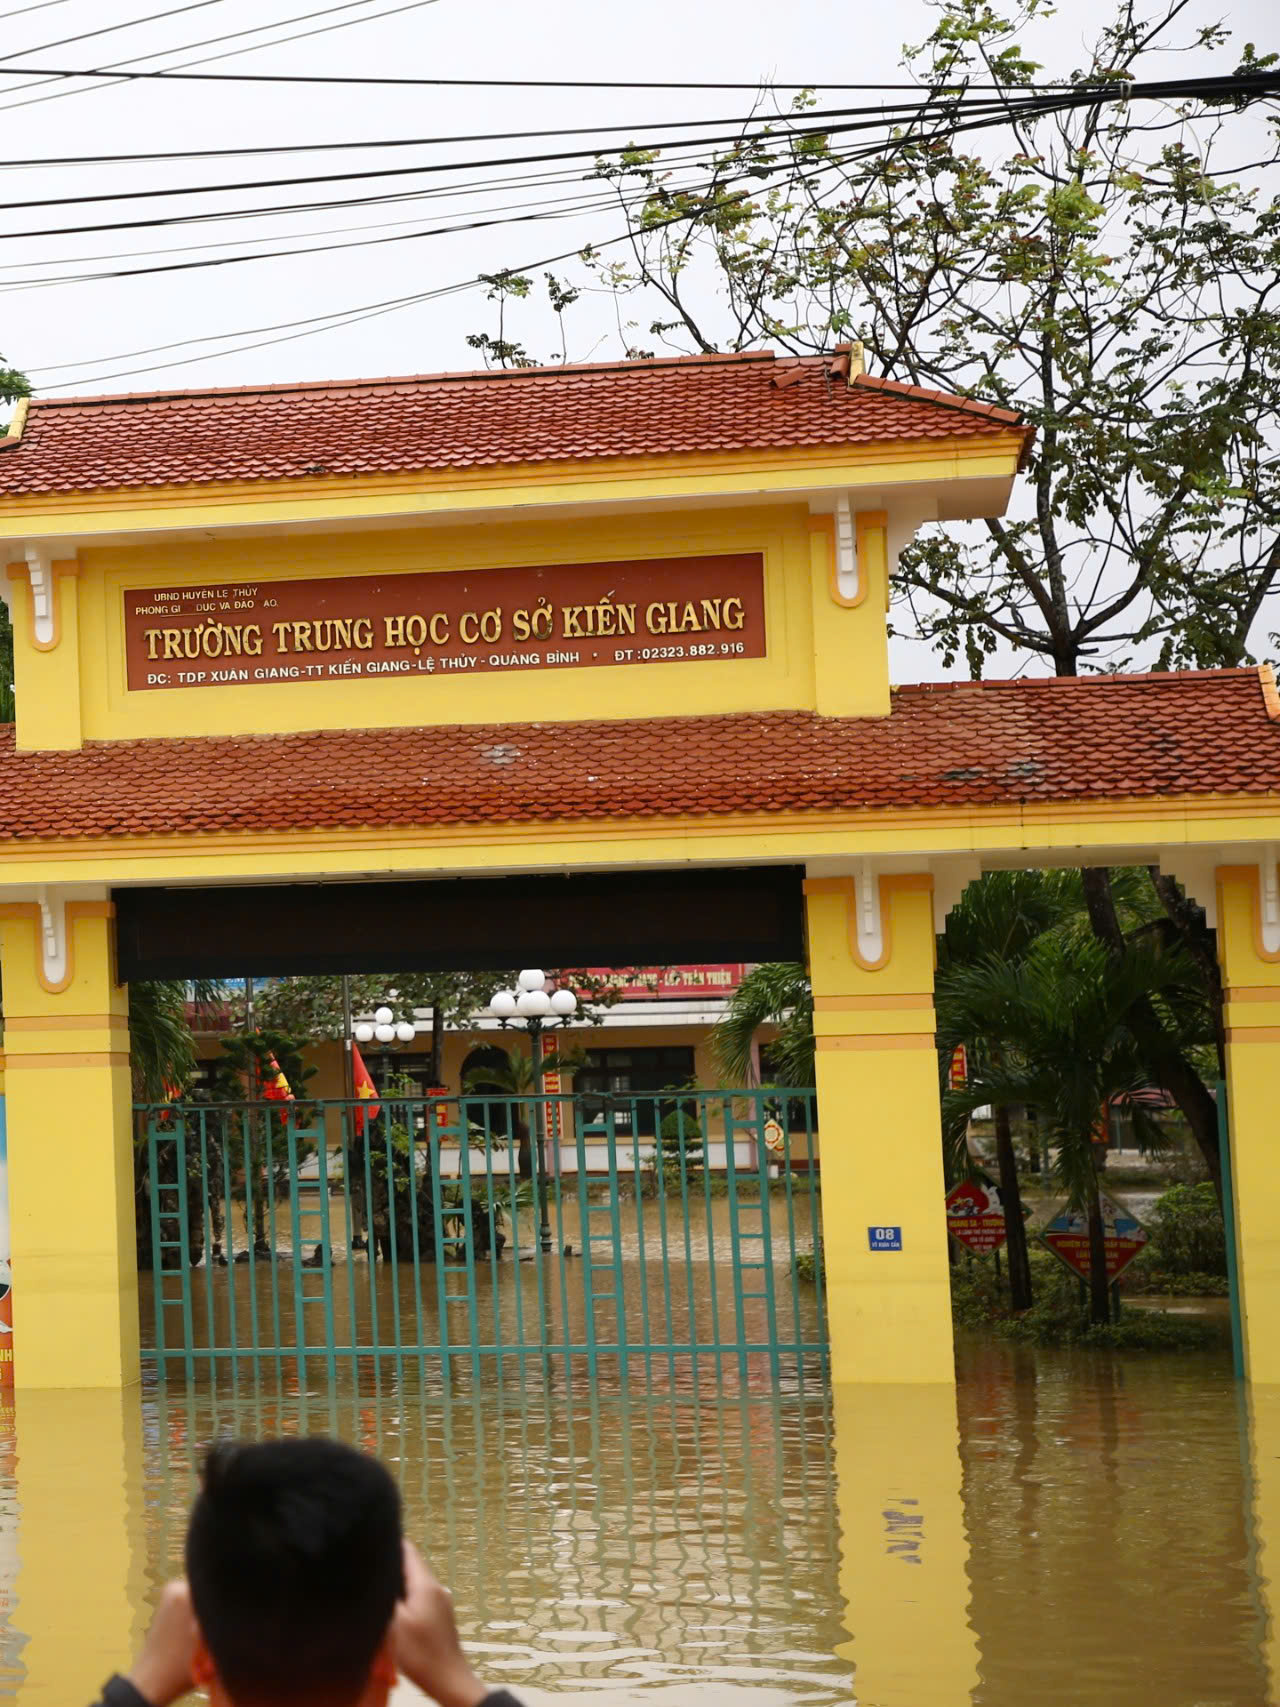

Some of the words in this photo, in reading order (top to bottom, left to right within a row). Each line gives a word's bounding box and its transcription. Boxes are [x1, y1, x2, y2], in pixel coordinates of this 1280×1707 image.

[154, 592, 180, 602] UBND
[144, 617, 264, 659] TRƯỜNG
[272, 617, 374, 653] TRUNG
[383, 613, 449, 656] HỌC
[459, 606, 502, 644] CƠ
[512, 596, 553, 642] SỞ
[562, 590, 637, 638] KIẾN
[646, 597, 745, 635] GIANG
[147, 673, 171, 685] ĐC:
[178, 671, 204, 683] TDP
[210, 667, 249, 682] XUÂN
[254, 664, 324, 680] GIANG-TT
[328, 657, 361, 676] KIẾN
[366, 656, 436, 675] GIANG-LỆ
[440, 653, 478, 669] THỦY
[489, 651, 540, 667] QUẢNG
[546, 650, 580, 664] BÌNH
[875, 1228, 895, 1240] 08
